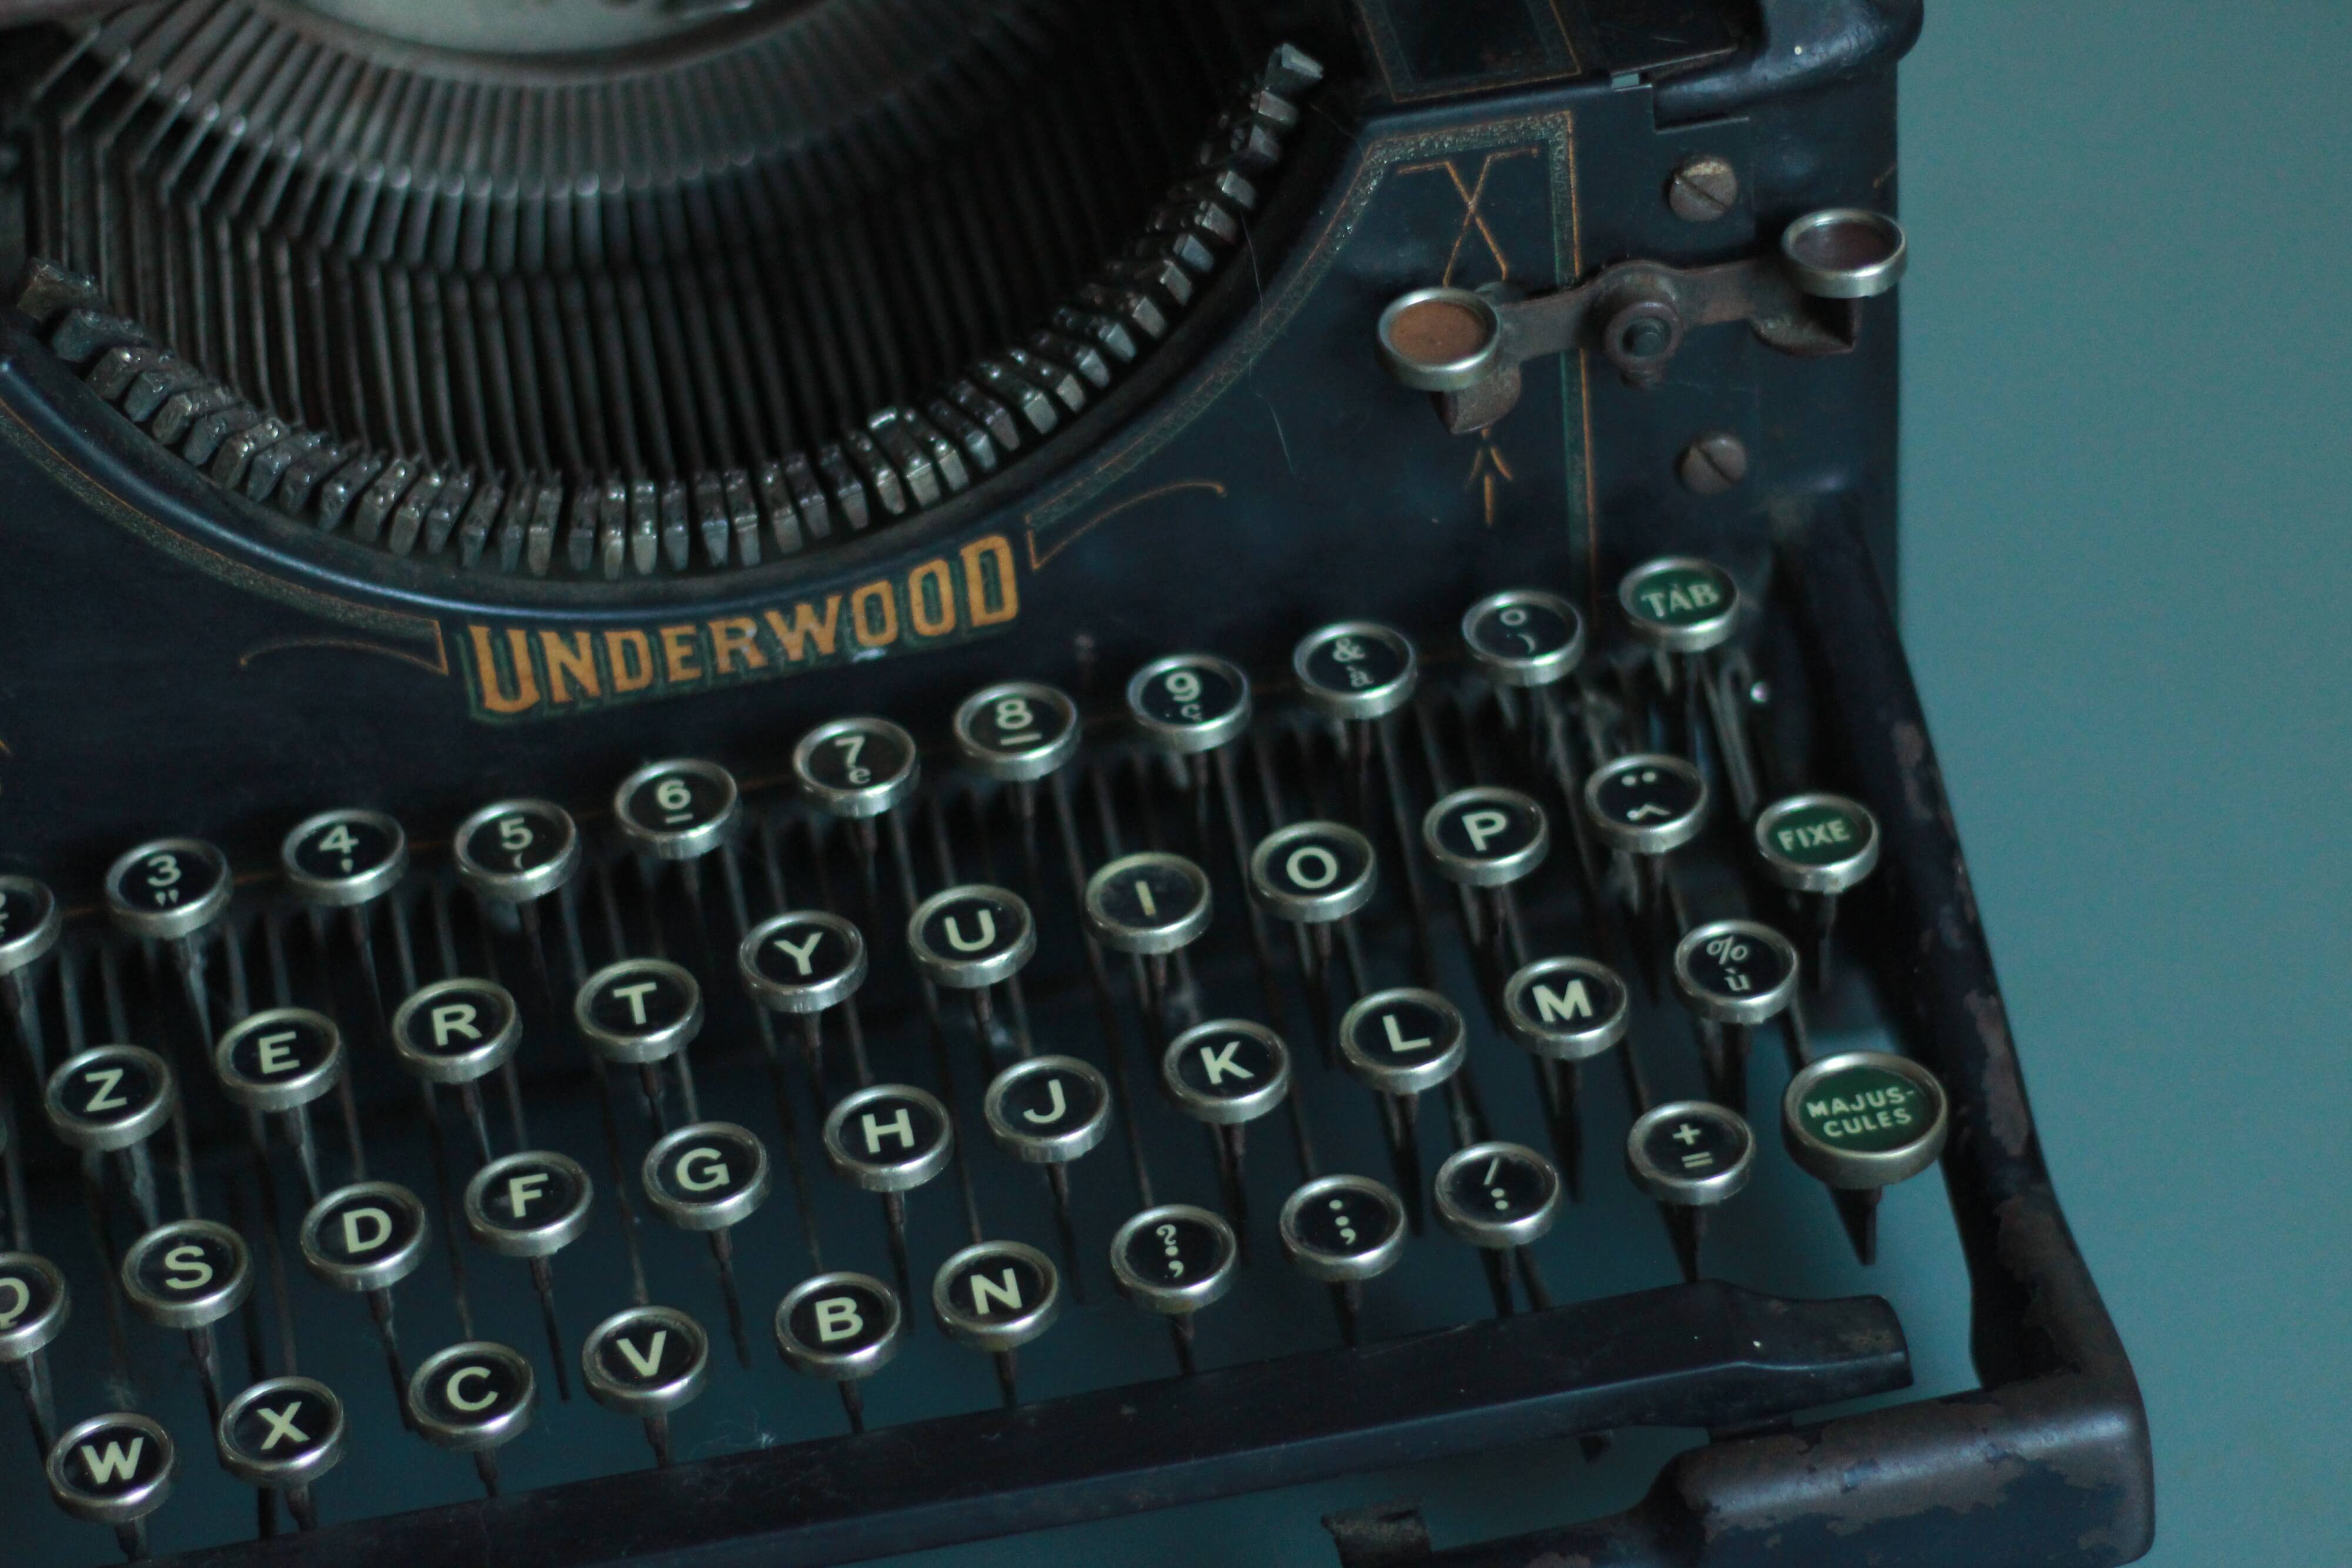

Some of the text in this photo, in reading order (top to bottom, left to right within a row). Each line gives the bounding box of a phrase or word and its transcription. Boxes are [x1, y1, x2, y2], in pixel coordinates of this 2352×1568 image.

[1641, 583, 1720, 618] TAB
[467, 533, 1021, 714] UNDERWOOD
[1332, 637, 1365, 662] &
[1165, 670, 1201, 703] 9
[995, 698, 1033, 730] 8
[835, 735, 864, 766] 7
[656, 779, 691, 810] 6
[318, 824, 359, 854] 4
[499, 817, 533, 850] 5
[1462, 810, 1508, 851] P
[1777, 818, 1851, 852] FIXE
[148, 854, 181, 887] 3
[1286, 846, 1338, 889] O
[1135, 880, 1157, 916] I
[944, 909, 995, 952] U
[1706, 935, 1748, 965] %
[773, 932, 823, 975] Y
[612, 982, 657, 1025] T
[1532, 979, 1593, 1023] M
[433, 1004, 483, 1047] R
[1382, 1014, 1432, 1052] L
[258, 1031, 300, 1074] E
[1200, 1041, 1254, 1085] K
[85, 1068, 127, 1112] Z
[1023, 1079, 1066, 1124] J
[1806, 1086, 1914, 1118] MAJUS-
[861, 1108, 915, 1154] H
[1822, 1108, 1913, 1138] CULES
[675, 1147, 730, 1192] G
[509, 1173, 549, 1218] F
[342, 1208, 392, 1253] D
[1155, 1223, 1180, 1259] ?
[164, 1245, 213, 1290] S
[970, 1268, 1023, 1315] N
[815, 1297, 863, 1342] B
[616, 1330, 667, 1378] V
[446, 1366, 499, 1412] C
[257, 1401, 312, 1450] X
[81, 1437, 144, 1485] W
